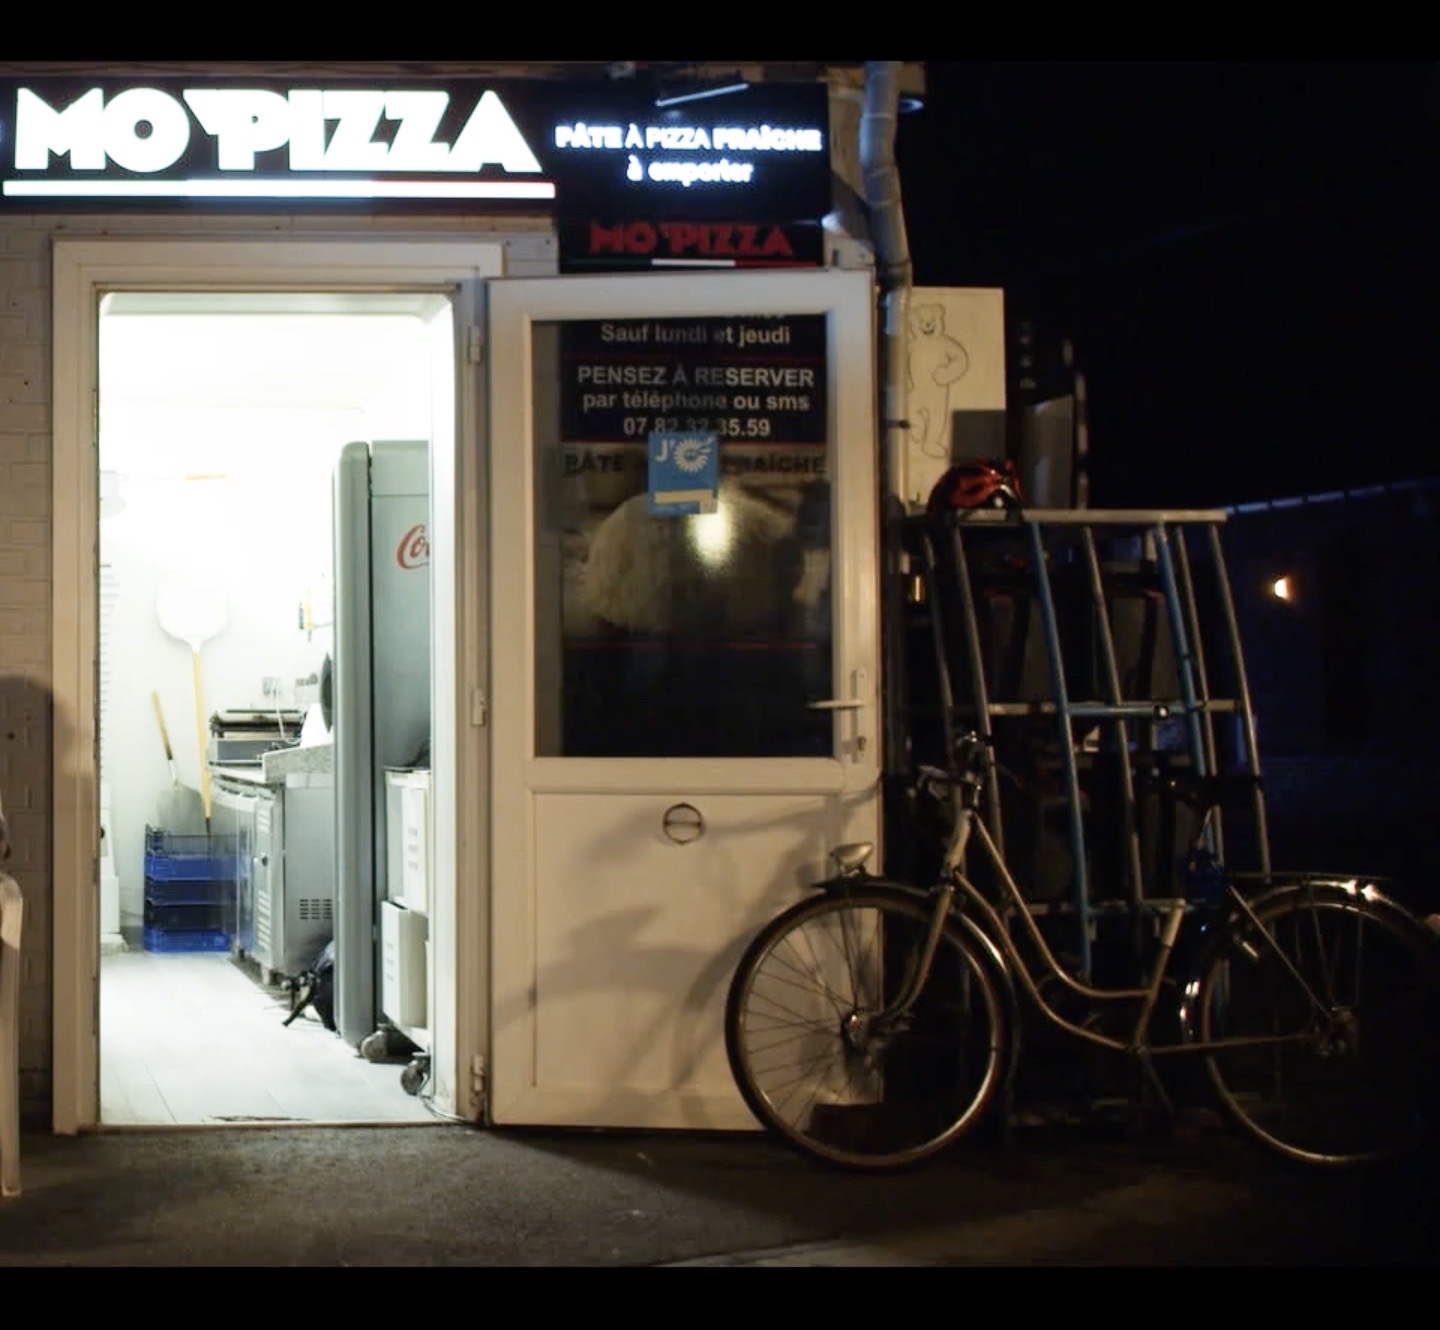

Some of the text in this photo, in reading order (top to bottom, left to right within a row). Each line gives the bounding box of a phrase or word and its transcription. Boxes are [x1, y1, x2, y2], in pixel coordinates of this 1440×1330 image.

[15, 88, 543, 172] MO'PIZZA
[554, 123, 823, 151] PÂTE À PIZZA FRAÎCHE
[626, 154, 754, 187] à emporter
[589, 220, 794, 255] MO'PIZZA
[600, 323, 648, 344] Sauf
[655, 323, 708, 344] lundi
[738, 325, 791, 349] jeudi
[577, 362, 815, 389] PENSEZ À RESERVER
[582, 389, 810, 413] par téléphone ou sms
